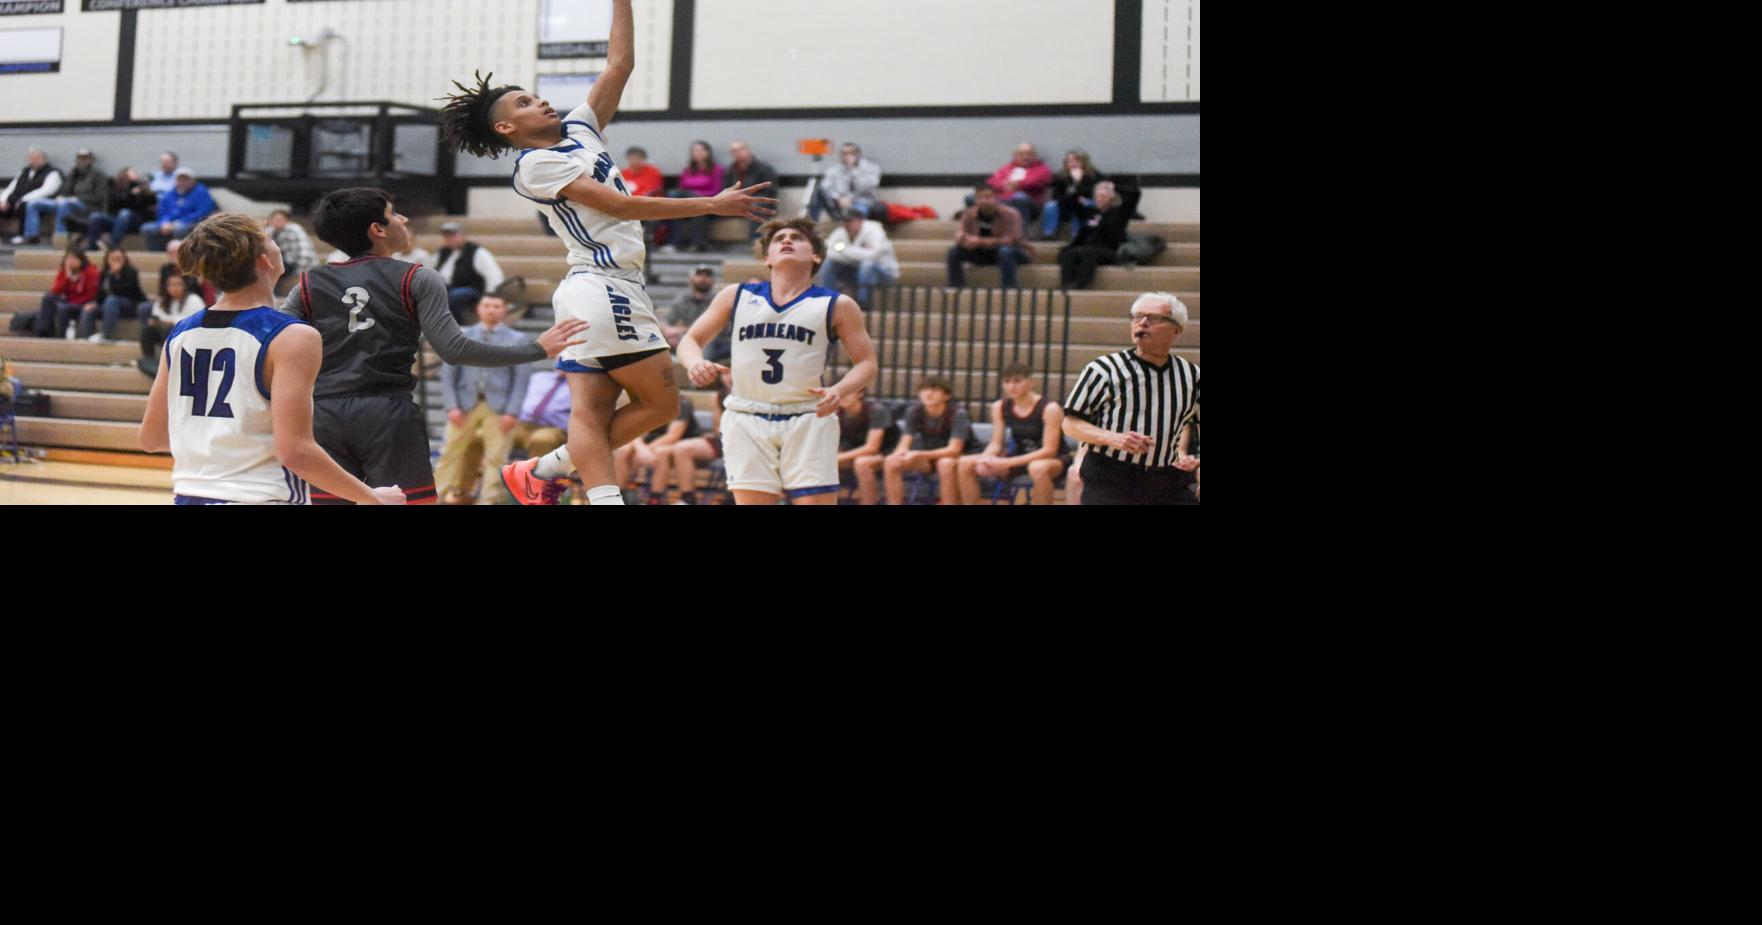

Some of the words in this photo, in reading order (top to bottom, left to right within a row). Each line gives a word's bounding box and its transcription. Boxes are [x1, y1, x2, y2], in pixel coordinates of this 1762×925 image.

[341, 286, 376, 333] 2
[739, 322, 816, 346] CONNEAUT
[180, 346, 236, 418] 42
[761, 348, 786, 385] 3
